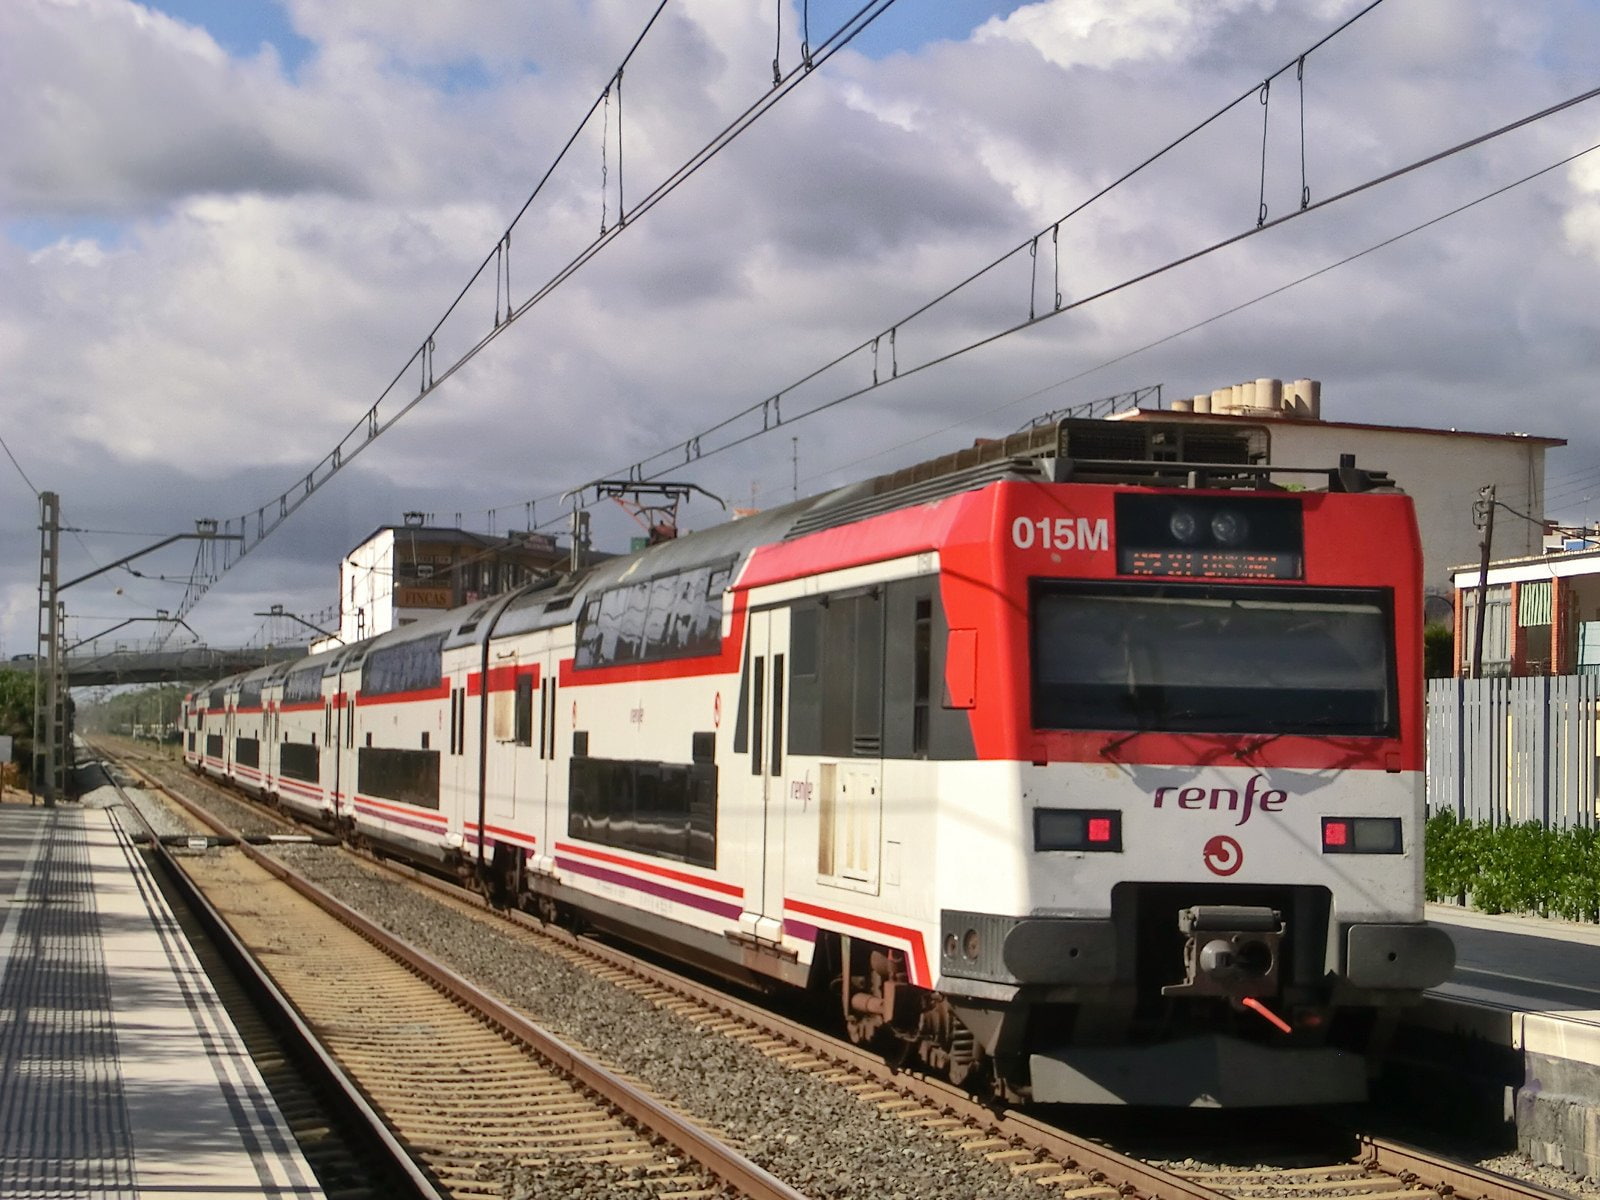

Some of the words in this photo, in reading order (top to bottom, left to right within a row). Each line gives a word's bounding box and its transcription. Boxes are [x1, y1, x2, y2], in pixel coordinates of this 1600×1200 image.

[1011, 516, 1109, 551] 015M
[404, 590, 448, 606] FINCAS
[791, 769, 814, 813] renfe
[1153, 773, 1288, 827] renfe
